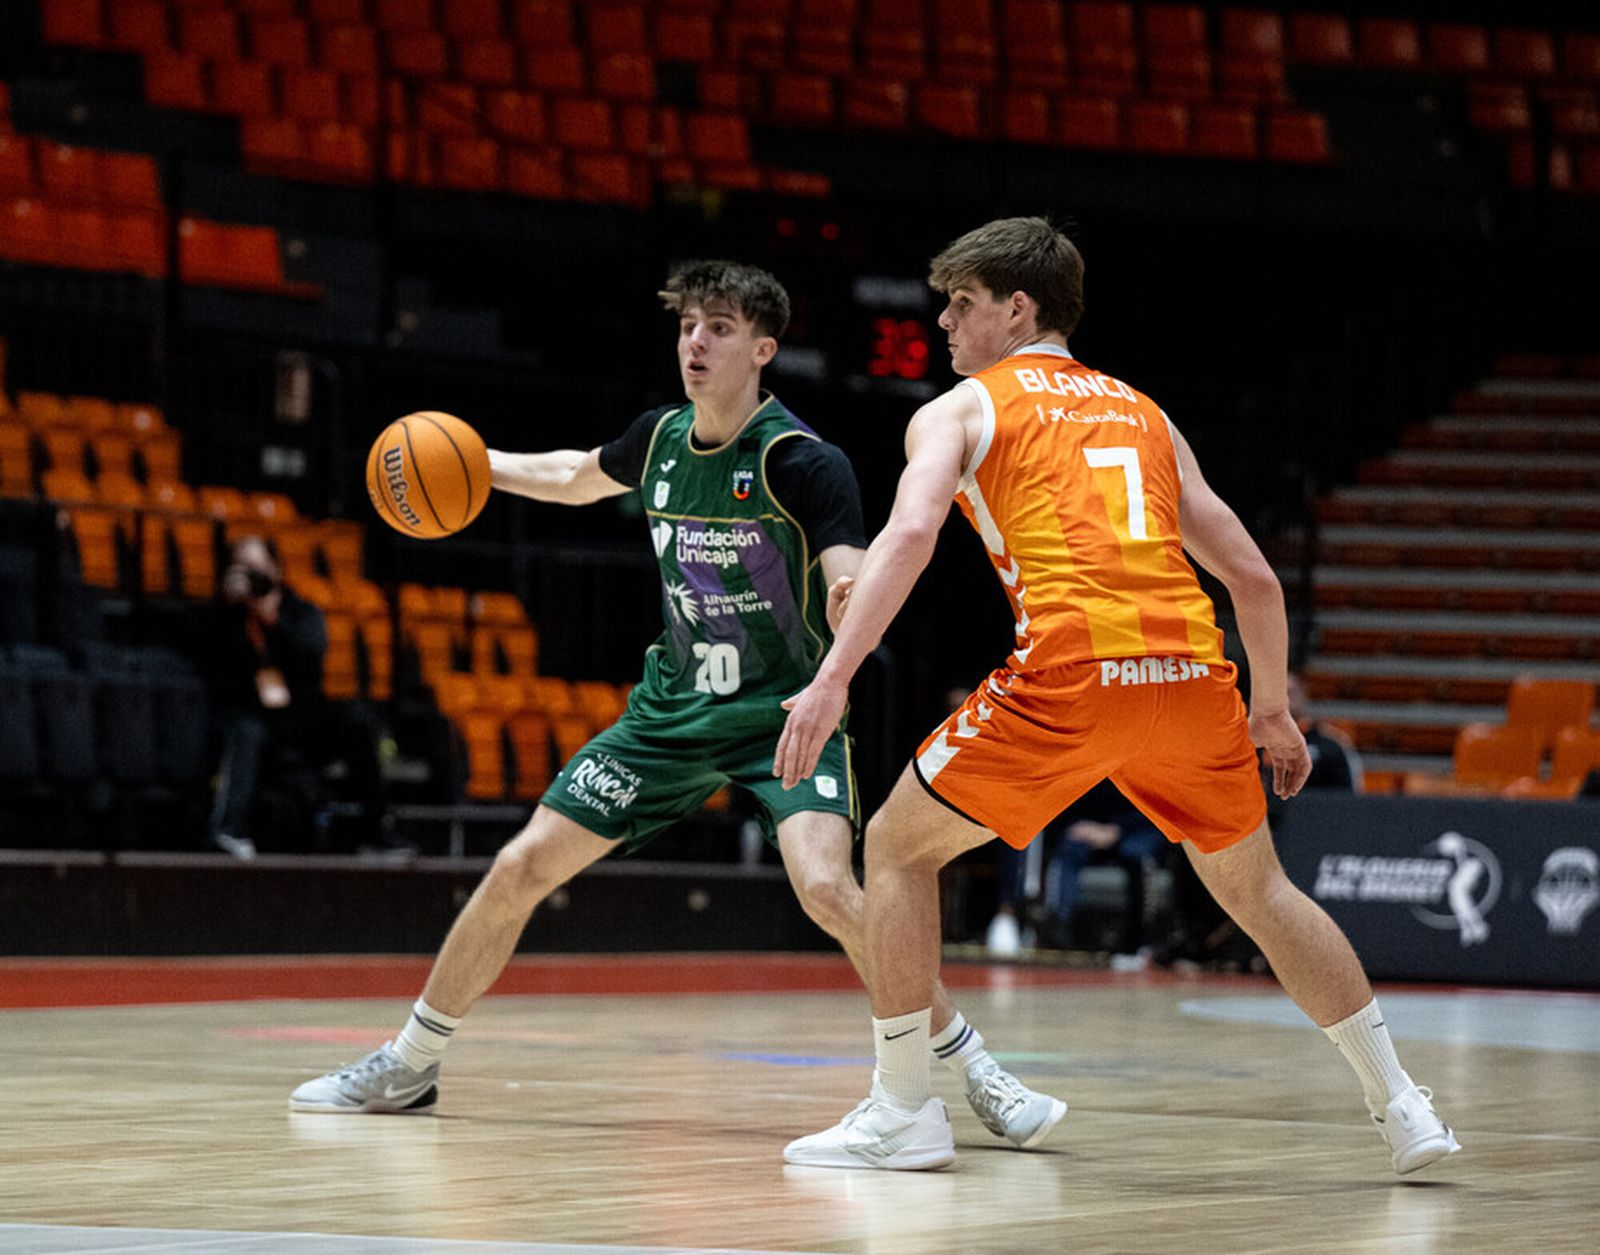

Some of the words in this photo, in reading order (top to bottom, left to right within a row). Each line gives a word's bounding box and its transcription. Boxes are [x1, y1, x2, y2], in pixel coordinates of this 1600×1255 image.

[1014, 368, 1137, 403] BLANCO
[384, 446, 421, 526] Wilson
[1082, 446, 1148, 541] 7
[676, 526, 761, 547] Fundación
[676, 545, 738, 568] Unicaja
[704, 605, 720, 617] de
[722, 603, 735, 615] la
[737, 600, 773, 613] Torre
[691, 641, 741, 696] 20
[1101, 657, 1210, 687] PAMESA
[567, 782, 611, 817] DENTAL
